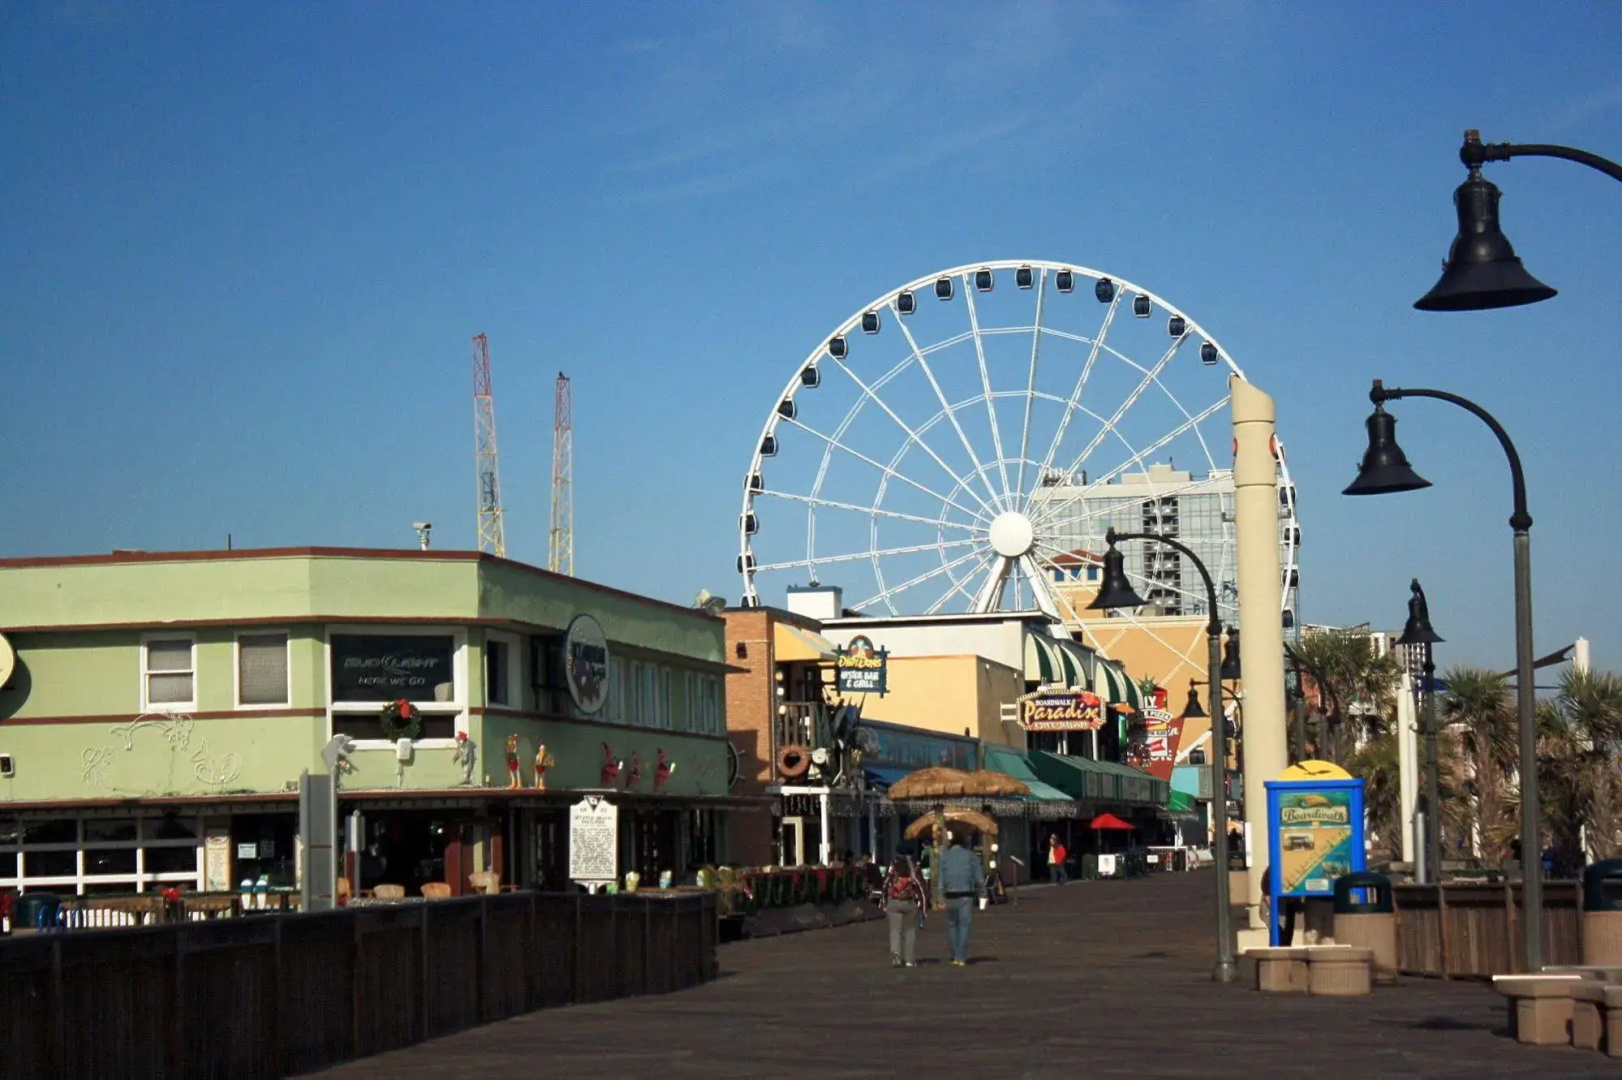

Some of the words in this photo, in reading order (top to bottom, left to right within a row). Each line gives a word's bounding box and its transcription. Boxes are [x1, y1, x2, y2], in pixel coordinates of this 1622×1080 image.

[358, 676, 387, 686] HERE
[390, 676, 407, 686] WE
[408, 677, 426, 686] GO
[1024, 699, 1099, 725] Paradise
[1284, 808, 1345, 822] Boardwalk
